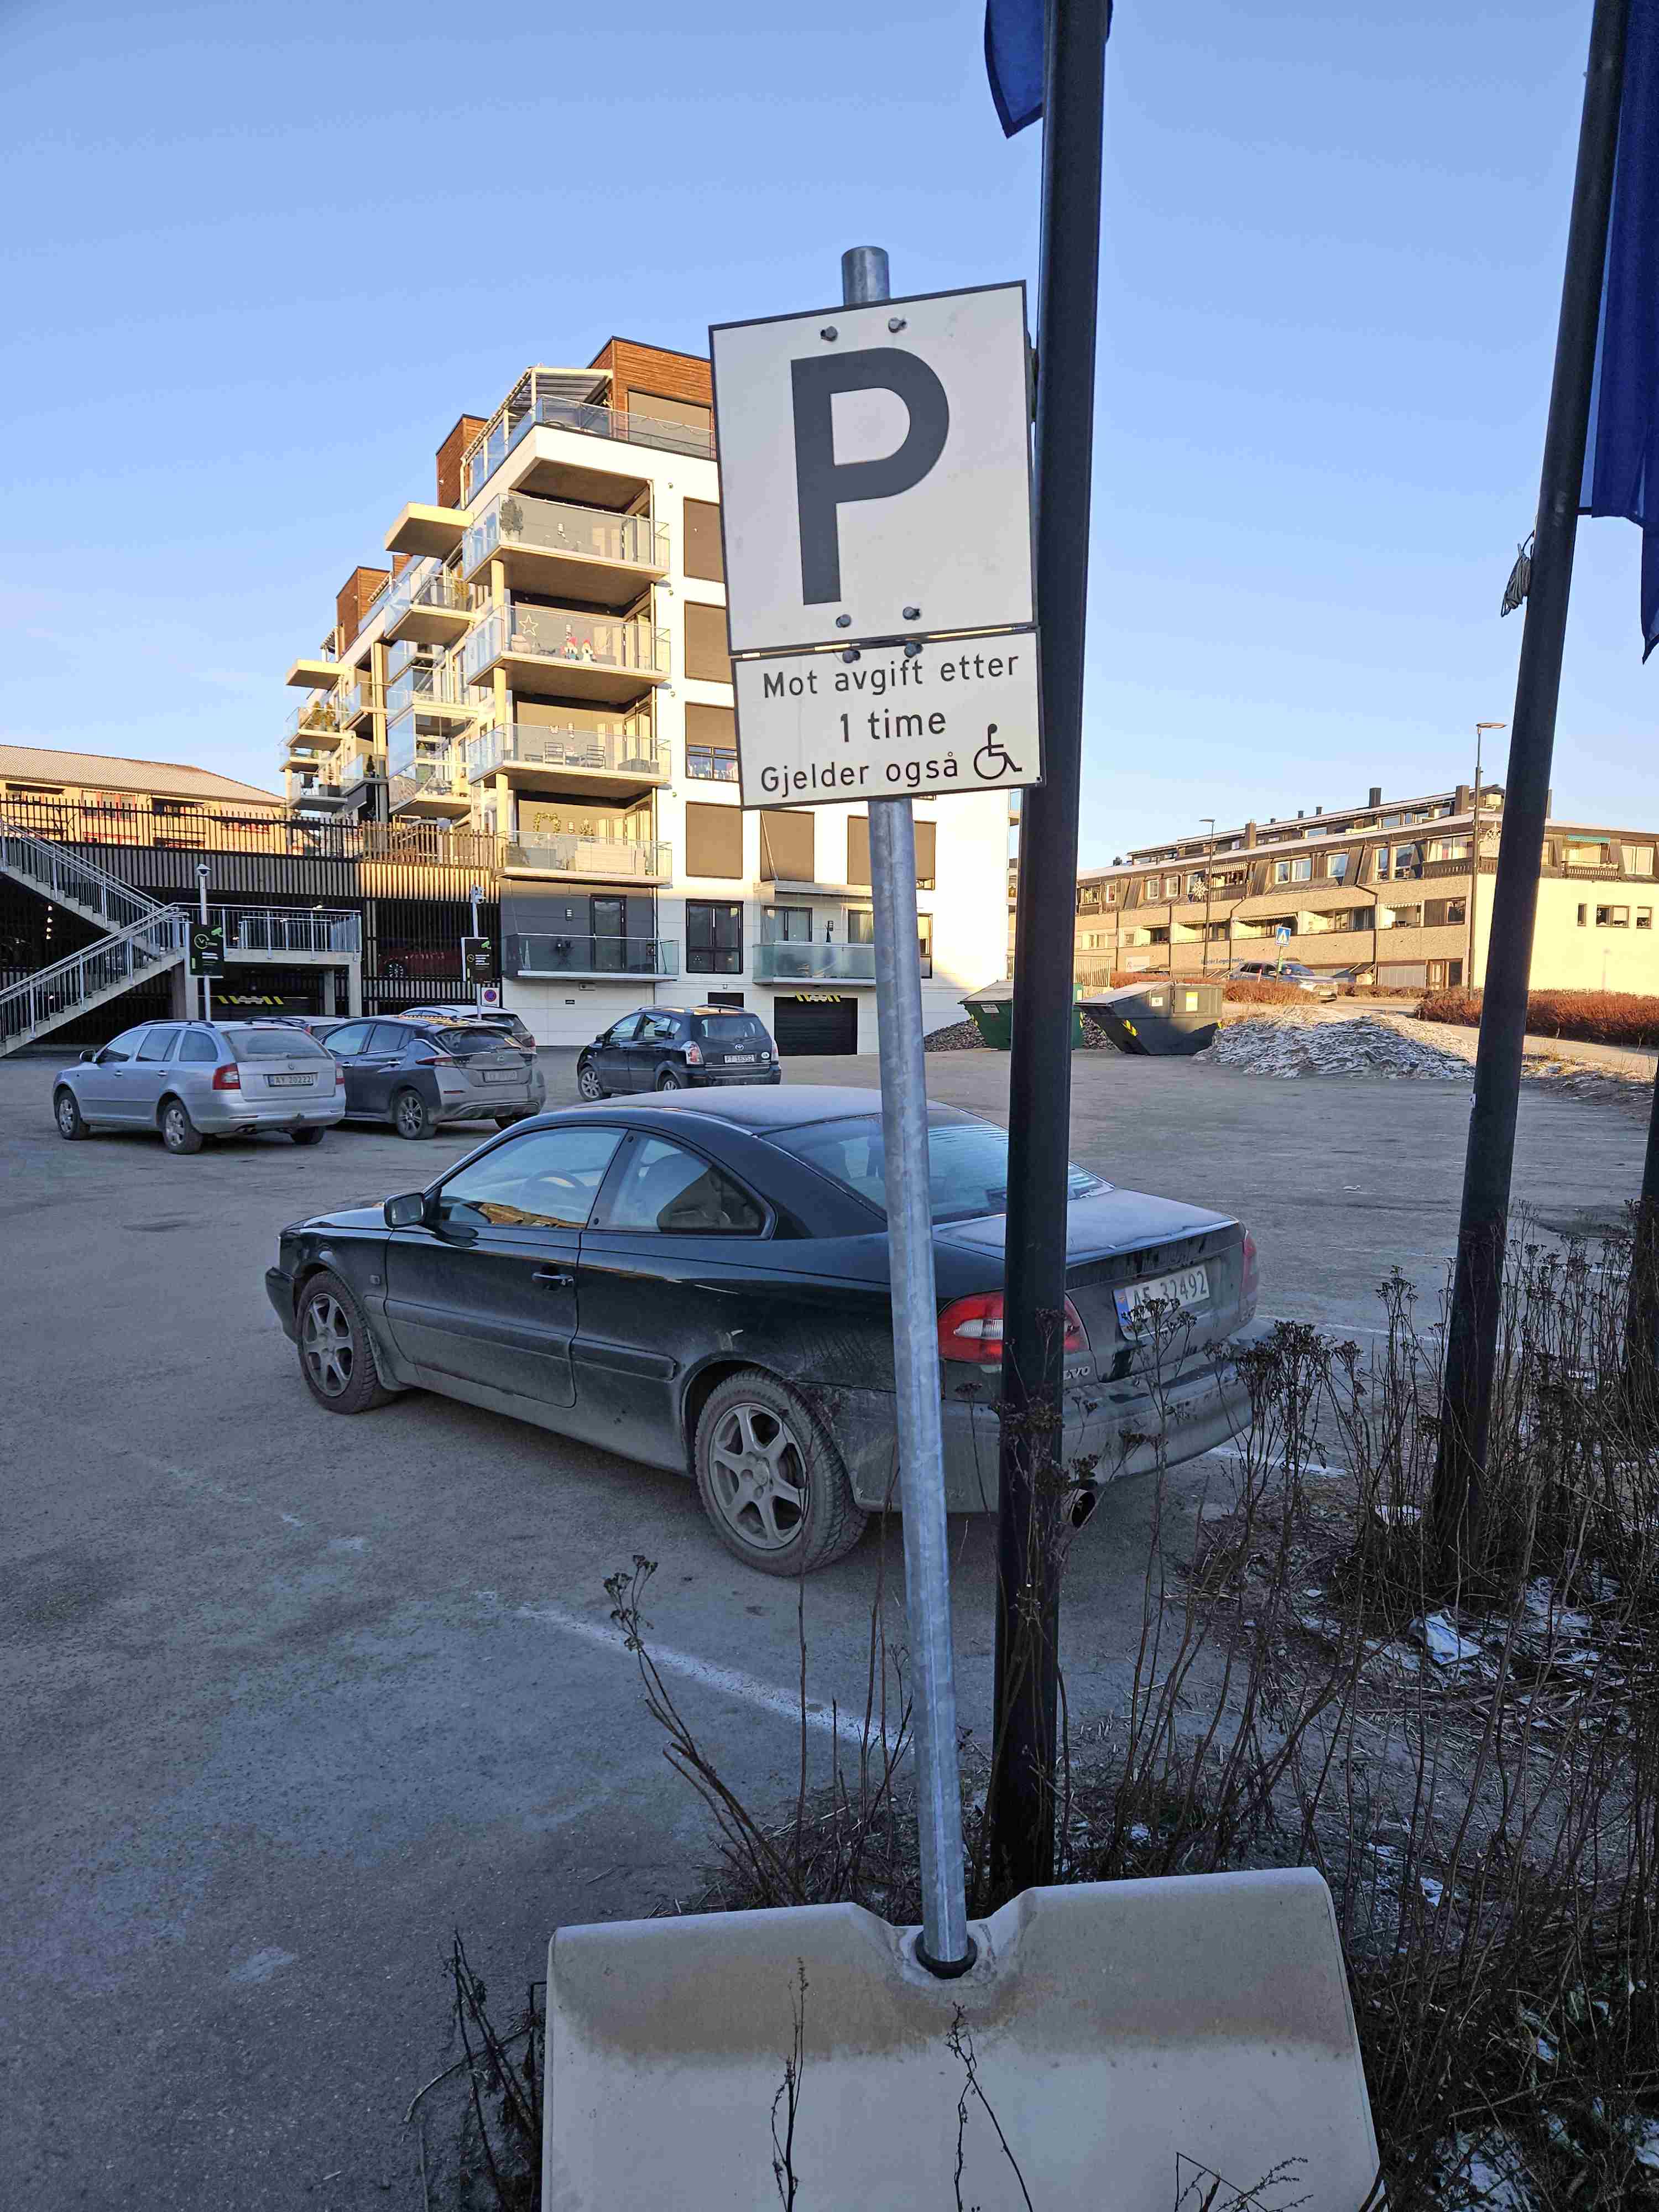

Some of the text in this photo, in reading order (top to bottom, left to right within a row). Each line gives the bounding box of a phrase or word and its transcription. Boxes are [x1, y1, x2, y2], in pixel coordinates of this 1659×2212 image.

[791, 347, 950, 606] P
[763, 654, 1019, 698] Mot avgift etter
[840, 708, 946, 743] 1 time
[761, 752, 958, 798] Gjelder også
[1063, 1366, 1091, 1380] LVO
